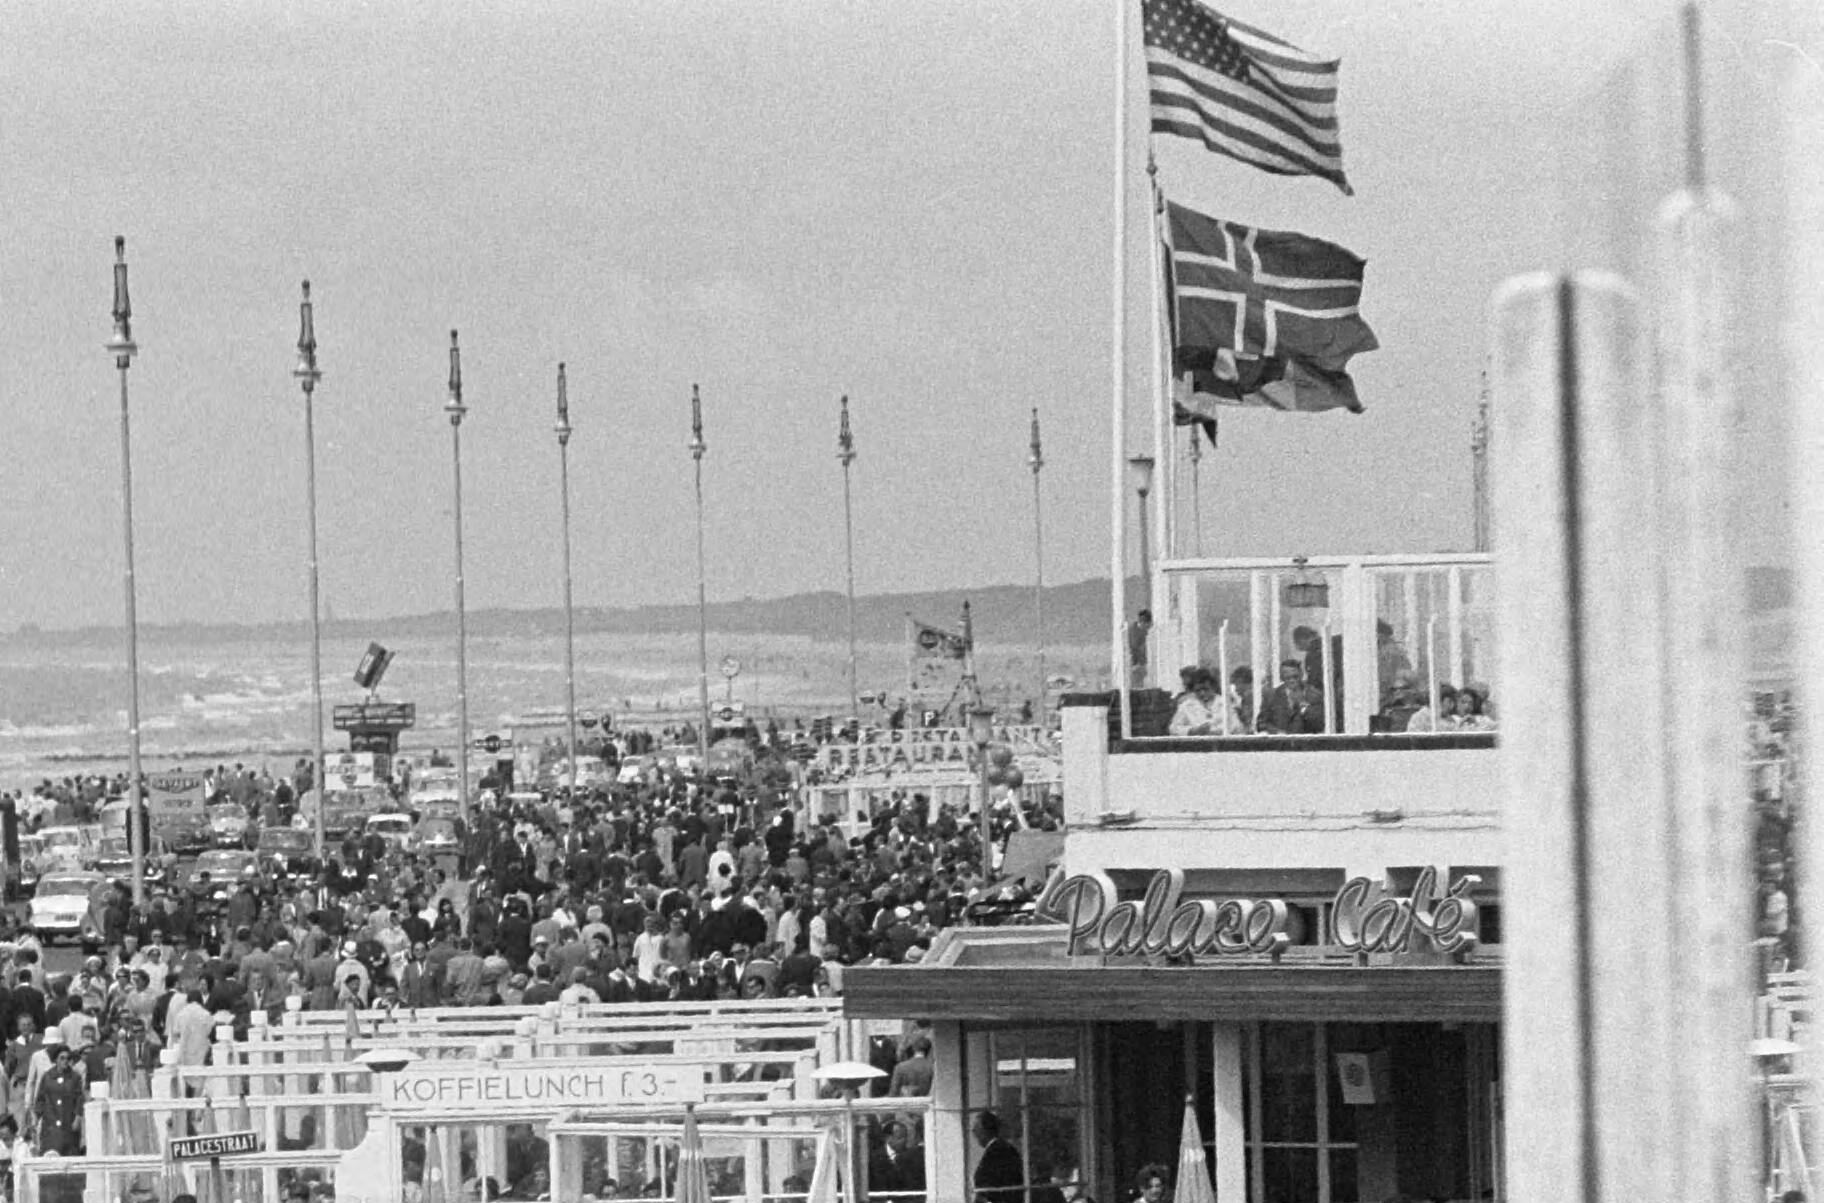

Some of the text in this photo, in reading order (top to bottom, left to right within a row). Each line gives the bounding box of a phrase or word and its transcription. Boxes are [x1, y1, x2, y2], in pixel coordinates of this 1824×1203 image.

[1046, 865, 1481, 957] Palace Café
[393, 1074, 604, 1101] KOFFIELUNCH
[173, 1135, 255, 1157] PALACESTRAAT
